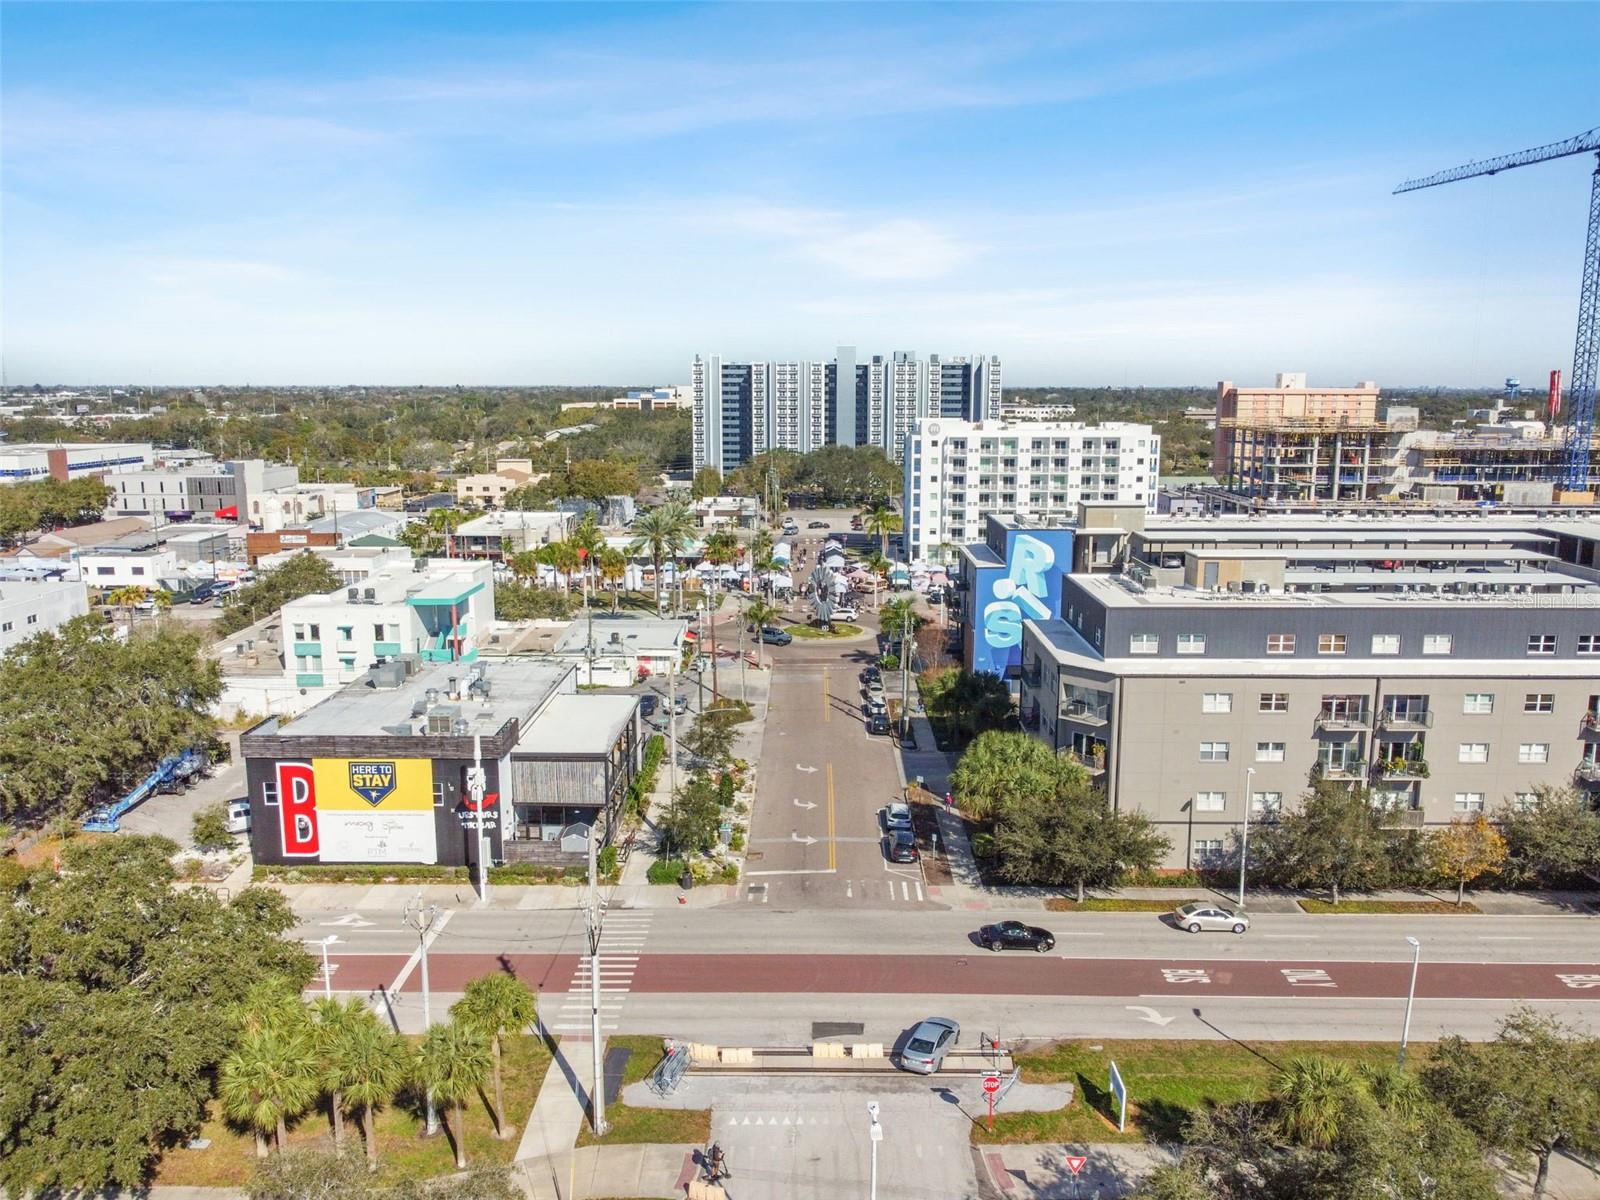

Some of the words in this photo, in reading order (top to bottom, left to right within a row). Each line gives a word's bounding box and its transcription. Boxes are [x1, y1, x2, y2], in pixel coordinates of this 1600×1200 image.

[352, 765, 378, 774] HERE
[380, 765, 392, 774] TO
[353, 774, 391, 787] STAY
